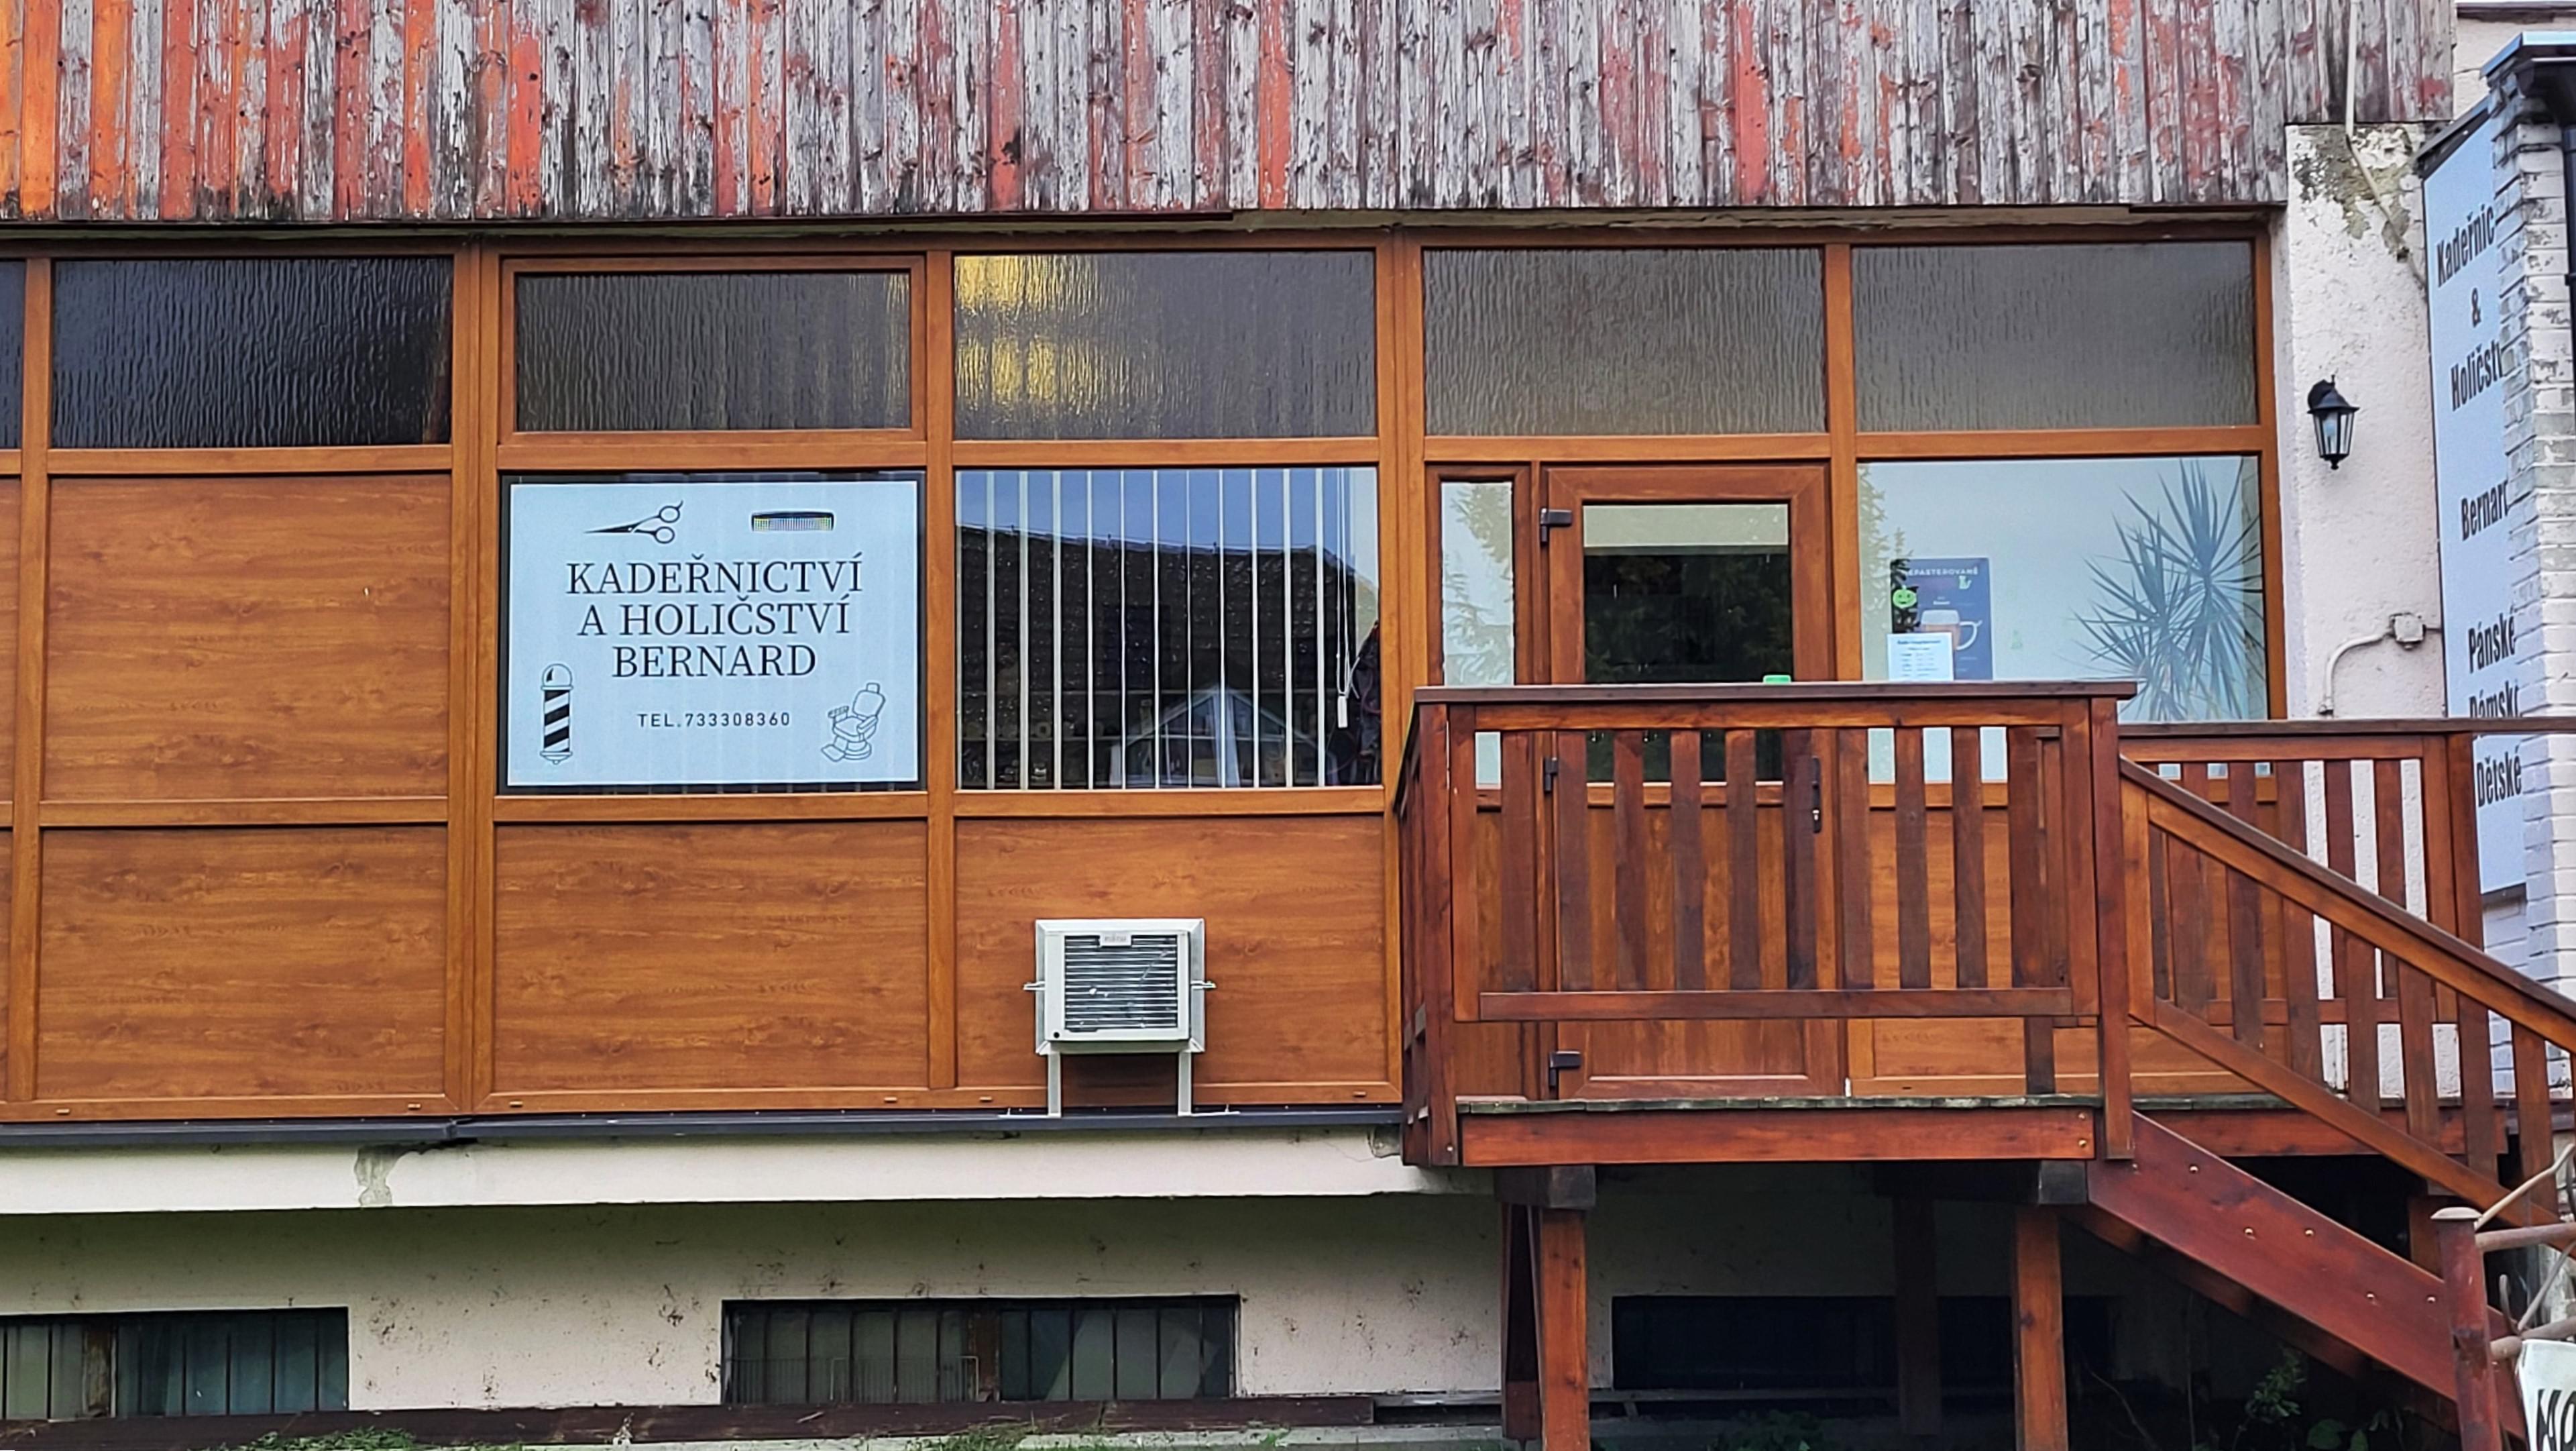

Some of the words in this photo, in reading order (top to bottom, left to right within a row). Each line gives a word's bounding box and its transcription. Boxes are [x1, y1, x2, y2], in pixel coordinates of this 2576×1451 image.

[2471, 287, 2481, 328] &
[566, 551, 862, 594] KADEŘNICTVÍ
[1903, 566, 1978, 576] EPASTEROVANÉ
[577, 604, 606, 636] A
[619, 594, 850, 636] HOLIČSTVÍ
[2468, 604, 2516, 674] Pánské
[612, 645, 816, 678] BERNARD
[638, 712, 790, 727] TEL.733308360
[2477, 745, 2522, 807] Dětské
